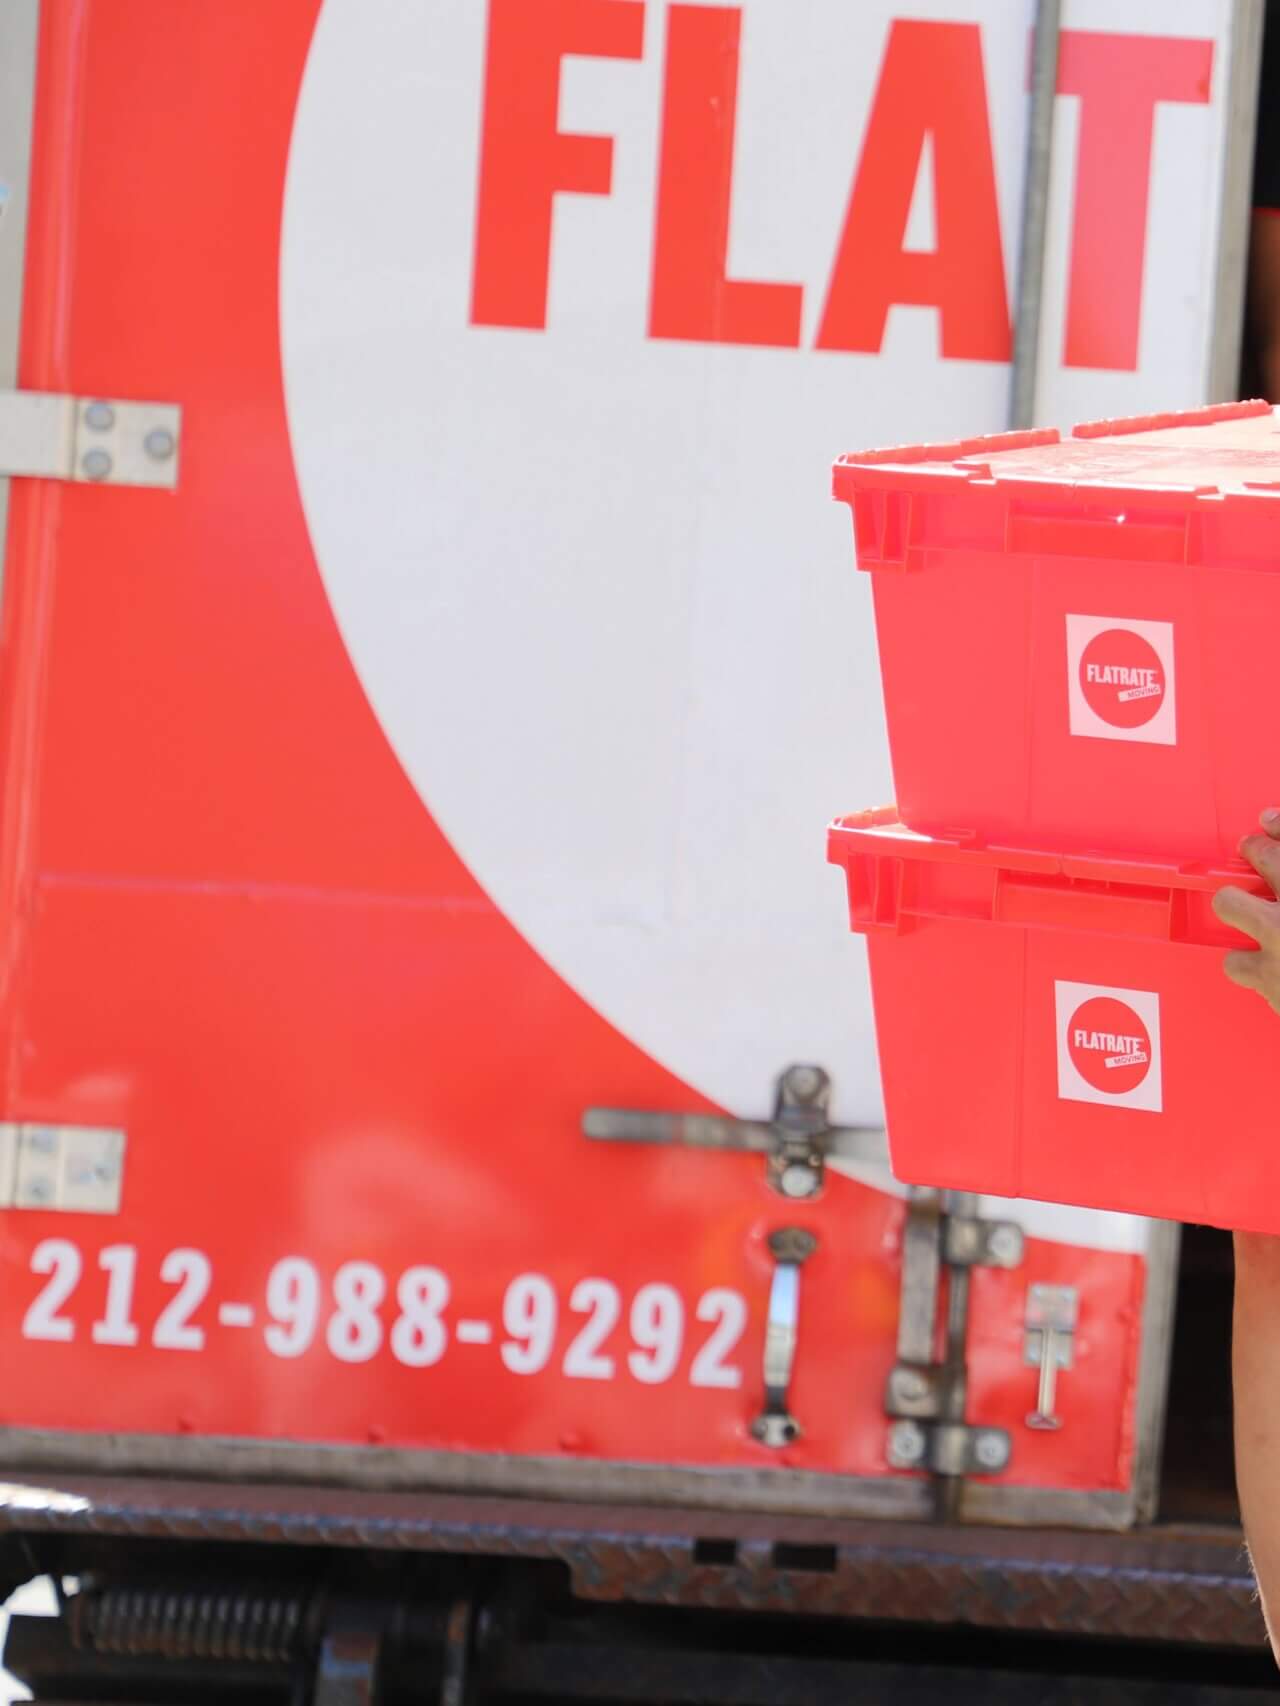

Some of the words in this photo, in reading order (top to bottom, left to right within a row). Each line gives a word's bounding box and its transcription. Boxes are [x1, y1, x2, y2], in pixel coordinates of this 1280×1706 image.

[468, 0, 1215, 372] FLAT
[1087, 664, 1157, 687] FLATRATE
[1127, 687, 1160, 698] MOVING
[1074, 1030, 1143, 1056] FLATRATE
[1114, 1055, 1146, 1065] MOVING
[22, 1238, 747, 1389] 212-988-9292
